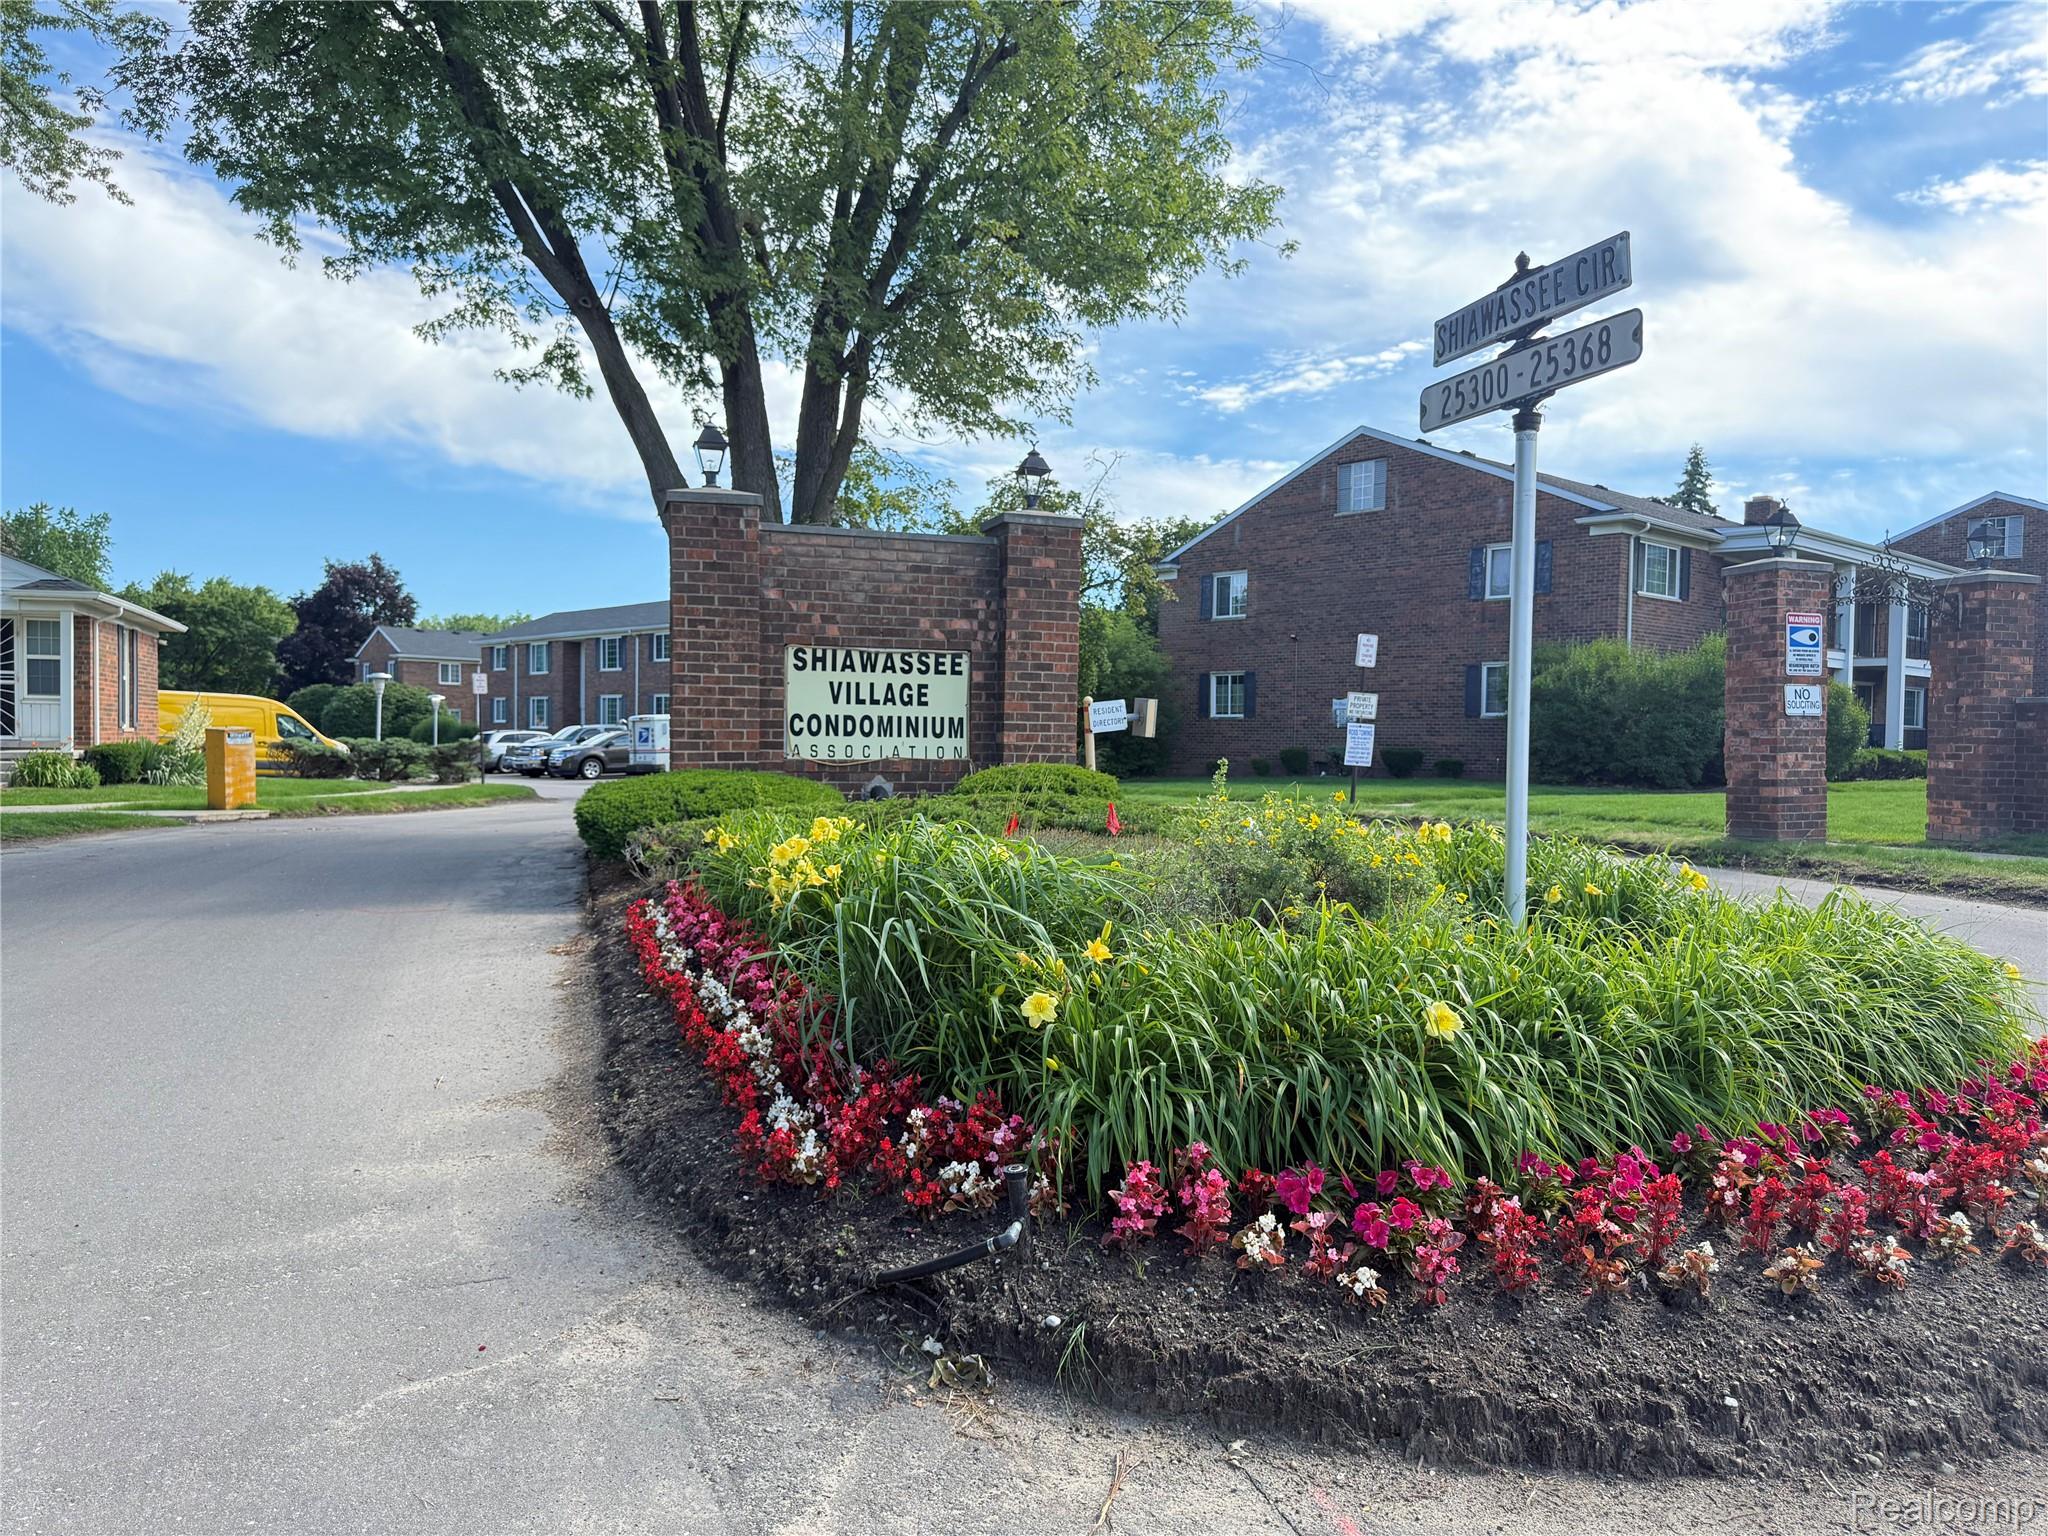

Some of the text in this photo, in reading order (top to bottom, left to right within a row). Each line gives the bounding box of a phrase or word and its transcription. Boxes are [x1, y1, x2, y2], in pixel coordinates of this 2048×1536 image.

[1437, 266, 1566, 358] SHIAWASSEE
[1788, 615, 1820, 624] WARNING
[793, 647, 963, 676] SHIAWASSEE
[829, 681, 929, 707] VILLAGE
[1353, 695, 1371, 703] PRIVATE
[1794, 689, 1811, 700] NO
[1349, 702, 1374, 710] PROPERTY
[1787, 700, 1820, 710] SOLICITING
[1093, 706, 1122, 715] RESIDENT
[789, 713, 964, 739] CONDOMINIUM
[1093, 718, 1125, 727] DIRECTORY
[792, 744, 963, 759] ASSOCIATION
